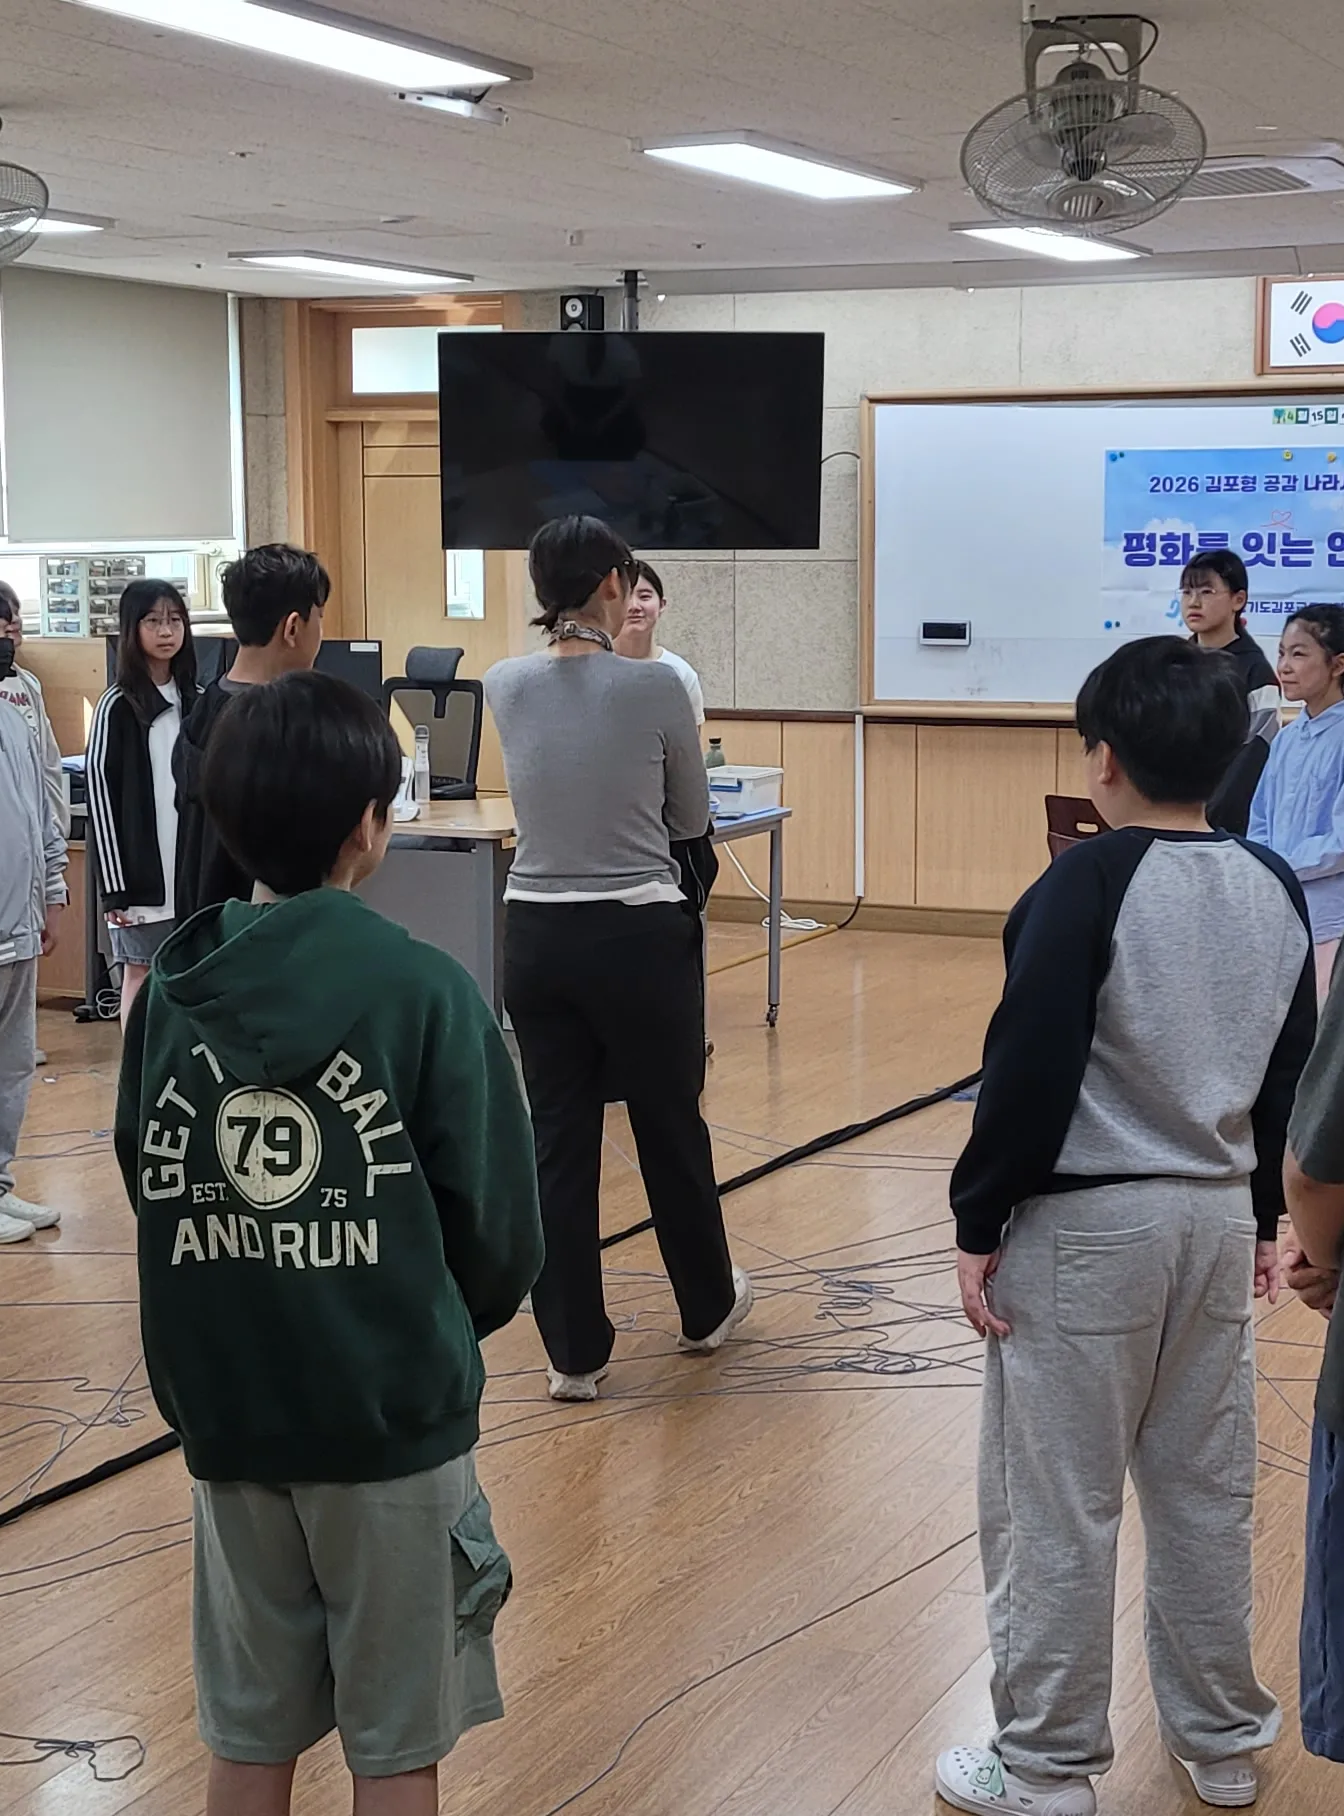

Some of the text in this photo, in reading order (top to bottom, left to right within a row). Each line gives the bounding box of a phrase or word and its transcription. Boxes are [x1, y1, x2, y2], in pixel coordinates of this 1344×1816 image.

[1149, 475, 1199, 493] 2026
[1205, 475, 1257, 493] 김포형
[1263, 474, 1299, 492] 공감
[1242, 531, 1315, 568] 잇는
[142, 1050, 413, 1202] GET BALL
[226, 1115, 303, 1178] 79
[320, 1188, 348, 1208] 75
[170, 1213, 379, 1270] AND RUN
